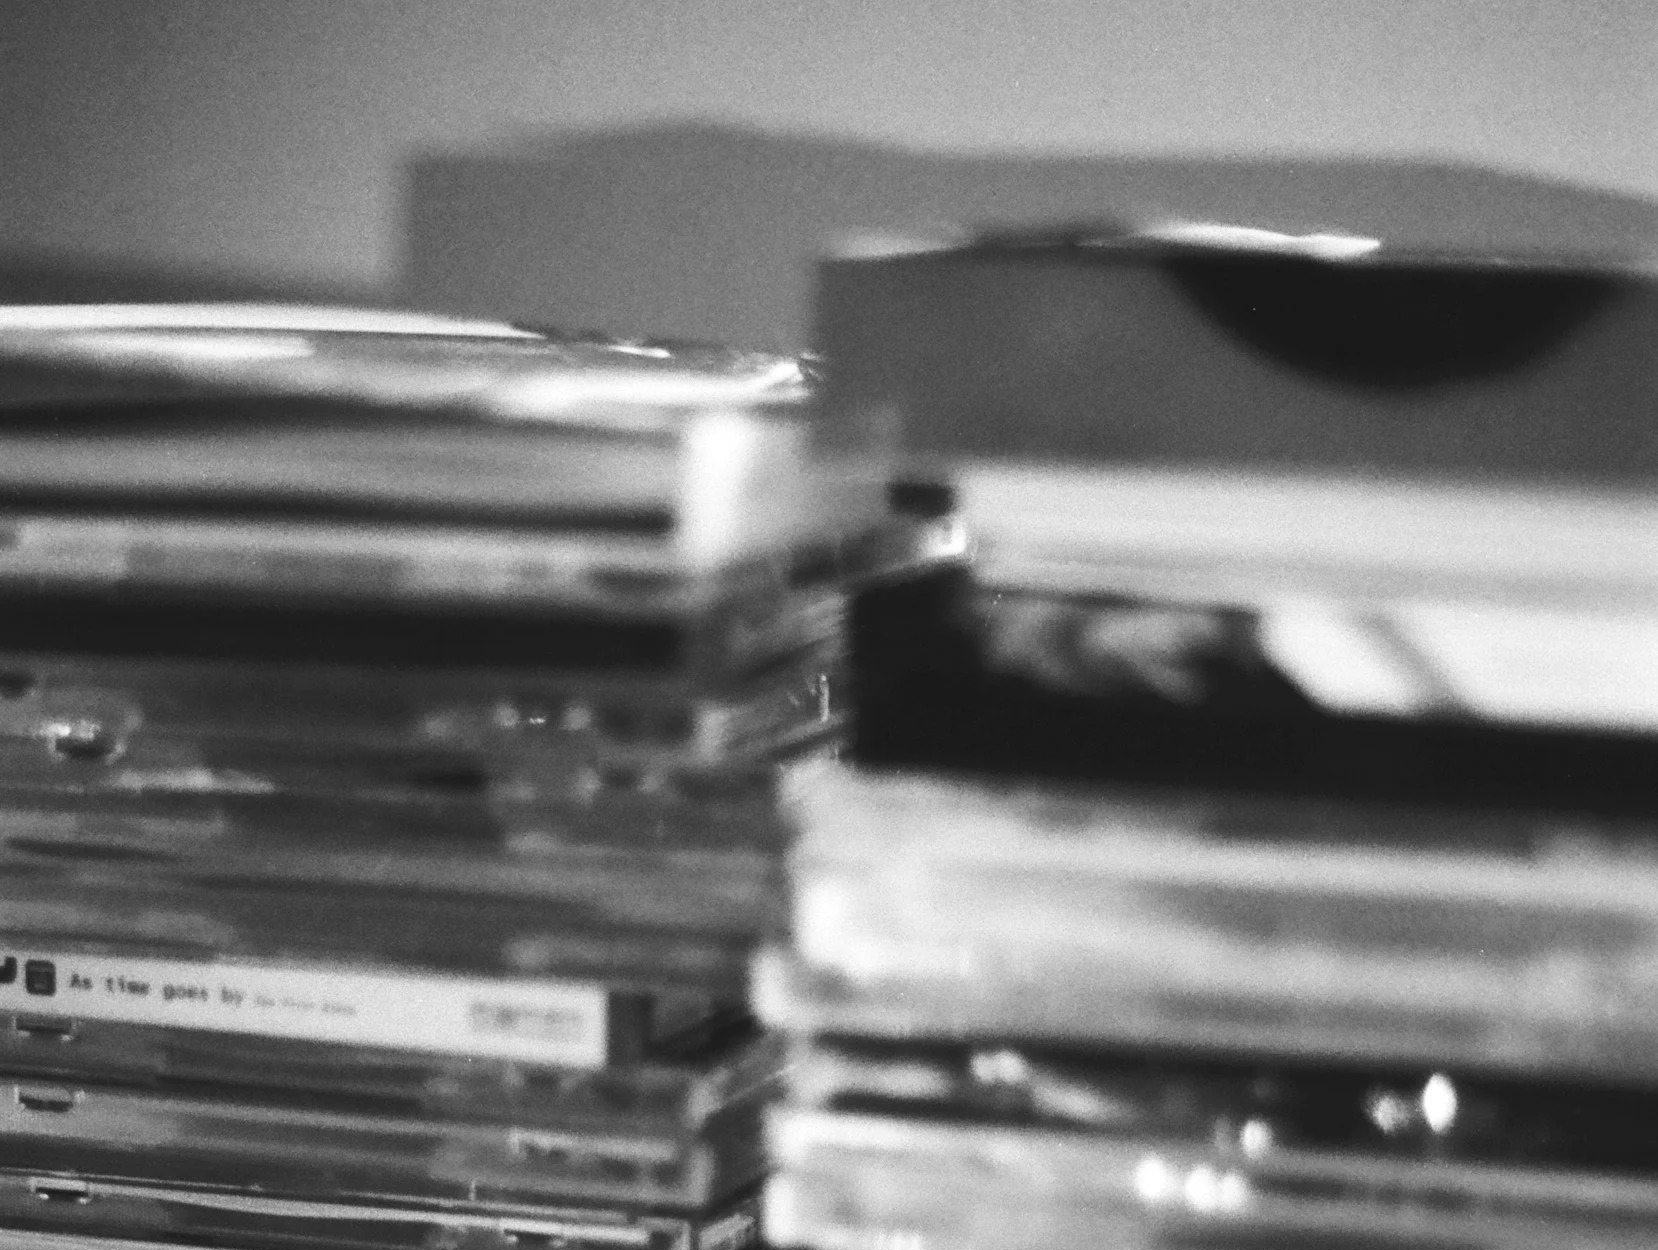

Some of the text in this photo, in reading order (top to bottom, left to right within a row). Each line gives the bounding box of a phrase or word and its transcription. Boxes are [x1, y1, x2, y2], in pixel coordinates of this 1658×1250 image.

[69, 972, 93, 990] As
[106, 976, 150, 996] time
[162, 983, 208, 1002] goes
[221, 985, 245, 1006] by
